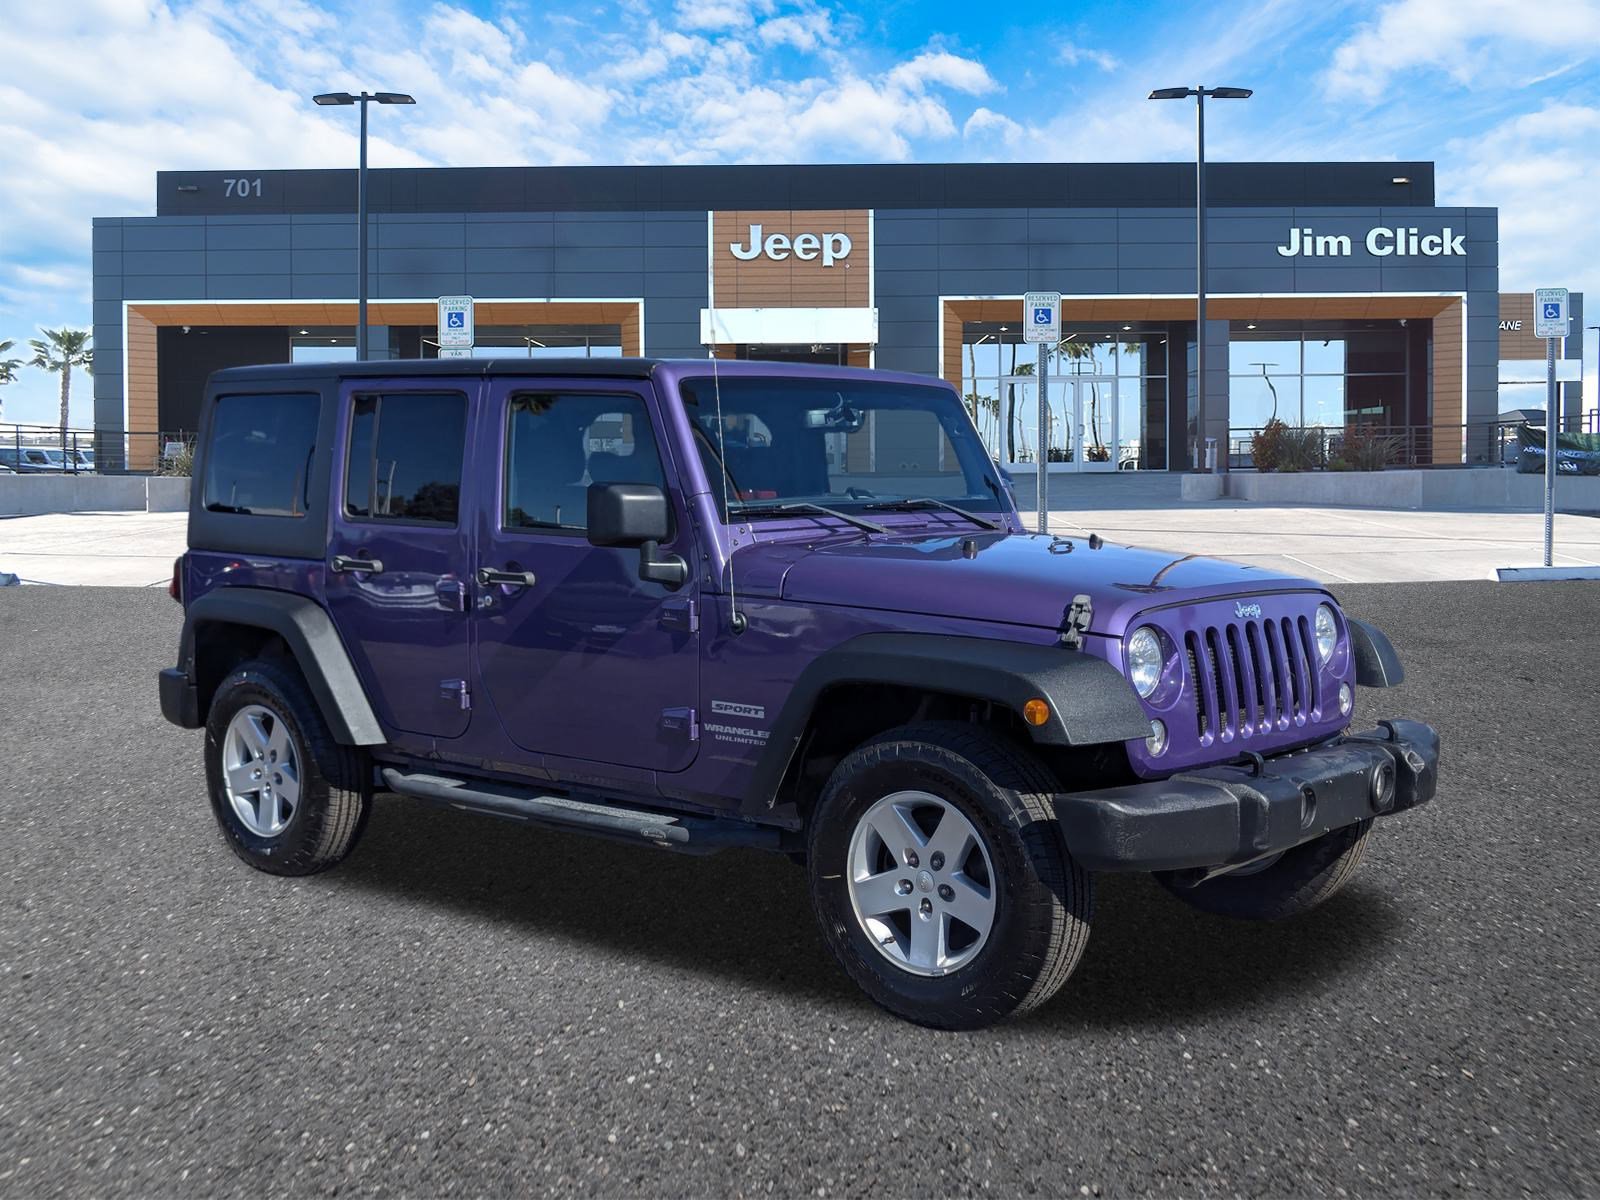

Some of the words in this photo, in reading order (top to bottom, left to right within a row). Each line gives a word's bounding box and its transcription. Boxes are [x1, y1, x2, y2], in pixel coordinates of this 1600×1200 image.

[223, 178, 262, 198] 701
[730, 224, 852, 267] Jeep
[1277, 227, 1352, 257] Jim
[1365, 227, 1467, 256] Click
[1235, 601, 1261, 619] Jeep
[714, 703, 764, 716] SPORT
[715, 734, 767, 746] UNLIMITED
